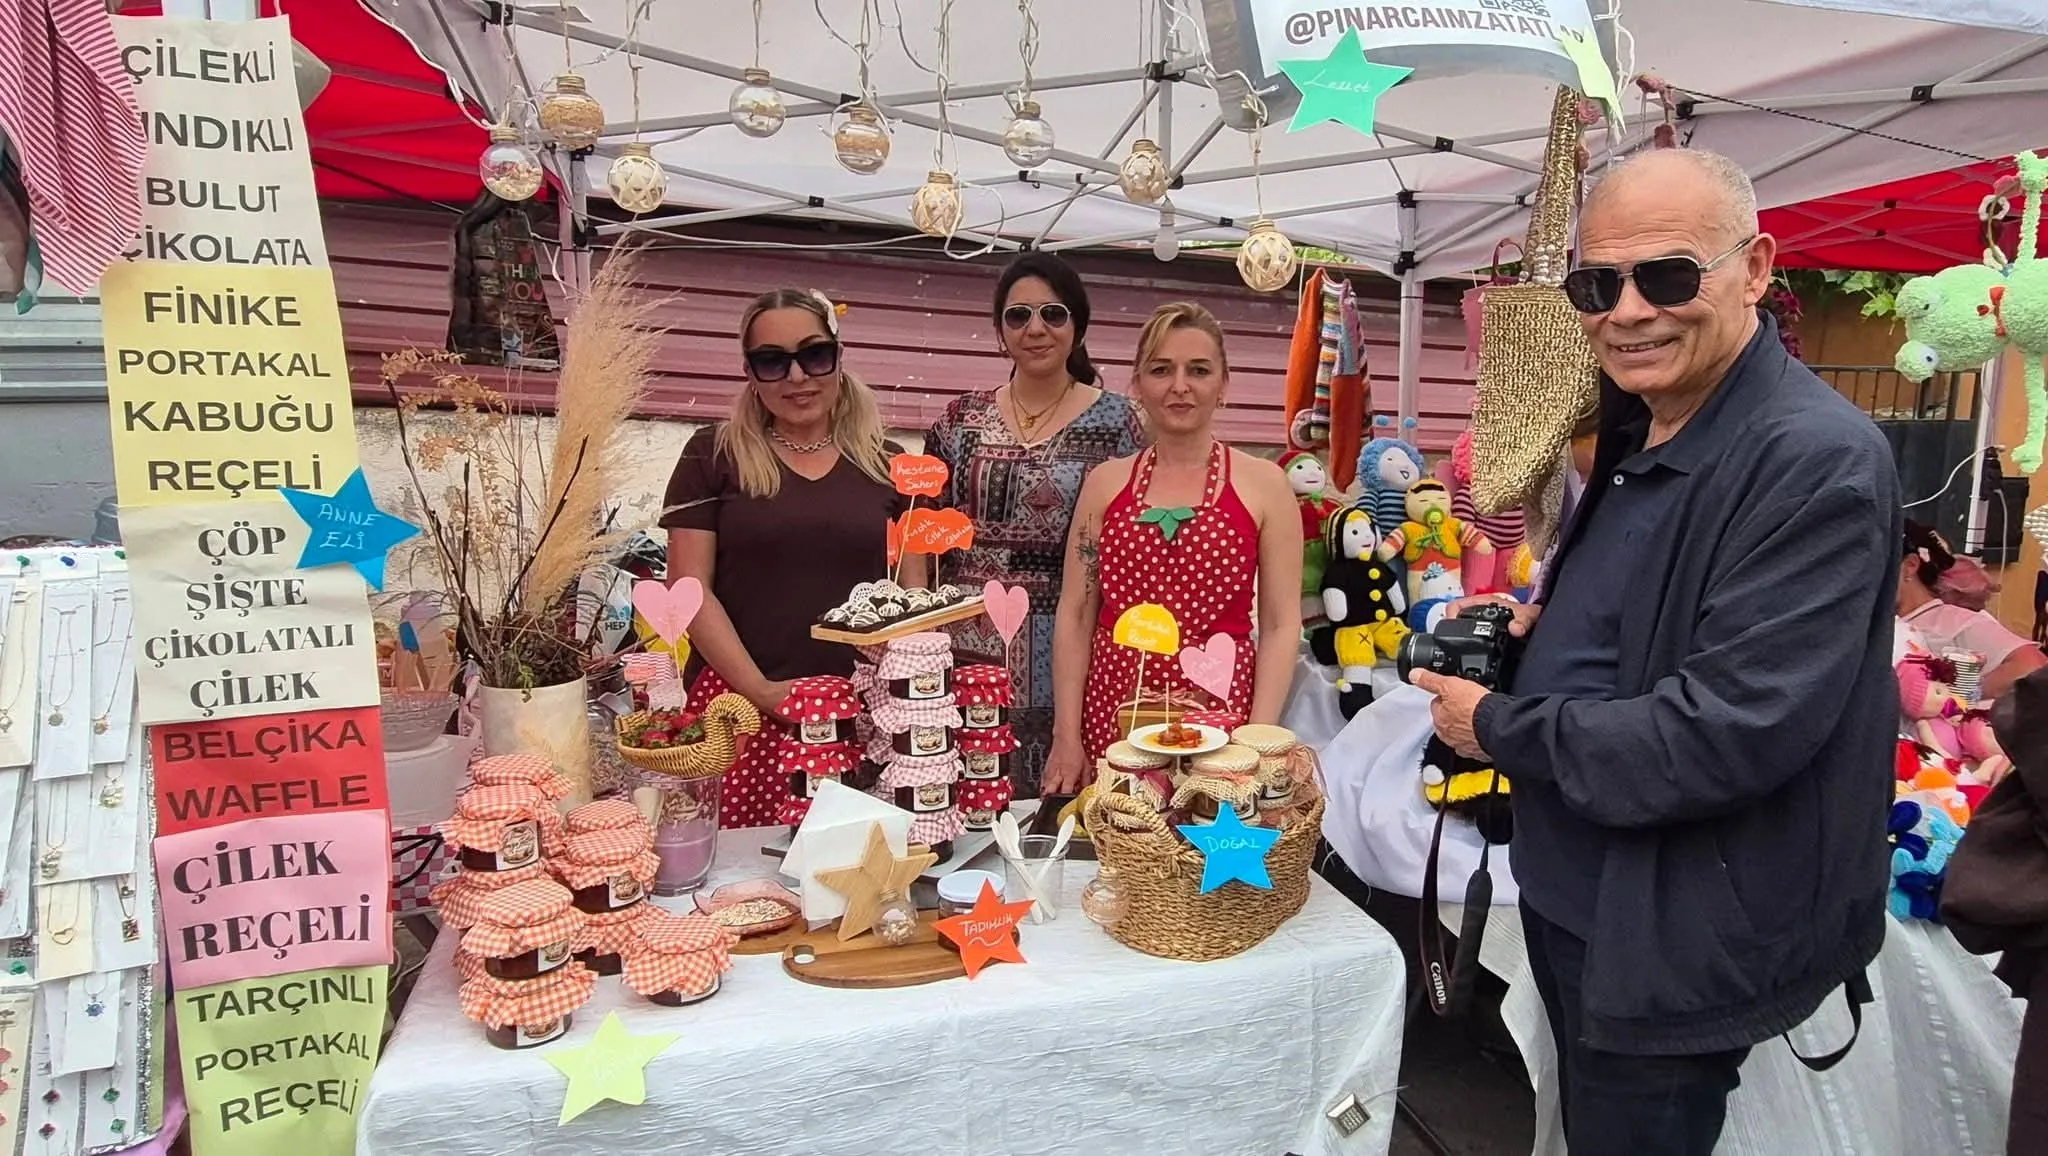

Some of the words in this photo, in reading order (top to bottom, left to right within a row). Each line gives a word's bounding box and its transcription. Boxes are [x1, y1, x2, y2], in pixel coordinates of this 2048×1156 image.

[121, 39, 276, 84] ÇİLEKLİ
[141, 111, 293, 152] INDIKLI
[146, 177, 281, 213] BULUT
[144, 285, 302, 327] FİNİKE
[119, 349, 331, 378] PORTAKAL
[124, 394, 334, 433] KABUĞU
[148, 454, 323, 498] REÇELİ
[317, 503, 382, 527] ANNE
[198, 521, 287, 566] ÇÖP
[319, 531, 367, 550] ELİ
[185, 574, 307, 620] ŞİŞTE
[144, 624, 356, 669] ÇİKOLATALI
[189, 670, 321, 717] ÇİLEK
[164, 718, 367, 766] BELÇİKA
[166, 774, 370, 821] WAFFLE
[172, 840, 341, 905] ÇİLEK
[178, 893, 371, 961] REÇELİ
[187, 974, 374, 1024] TARÇINLI
[1430, 961, 1447, 1005] Canon
[195, 1031, 370, 1081] PORTAKAL
[220, 1078, 359, 1132] REÇELİ
